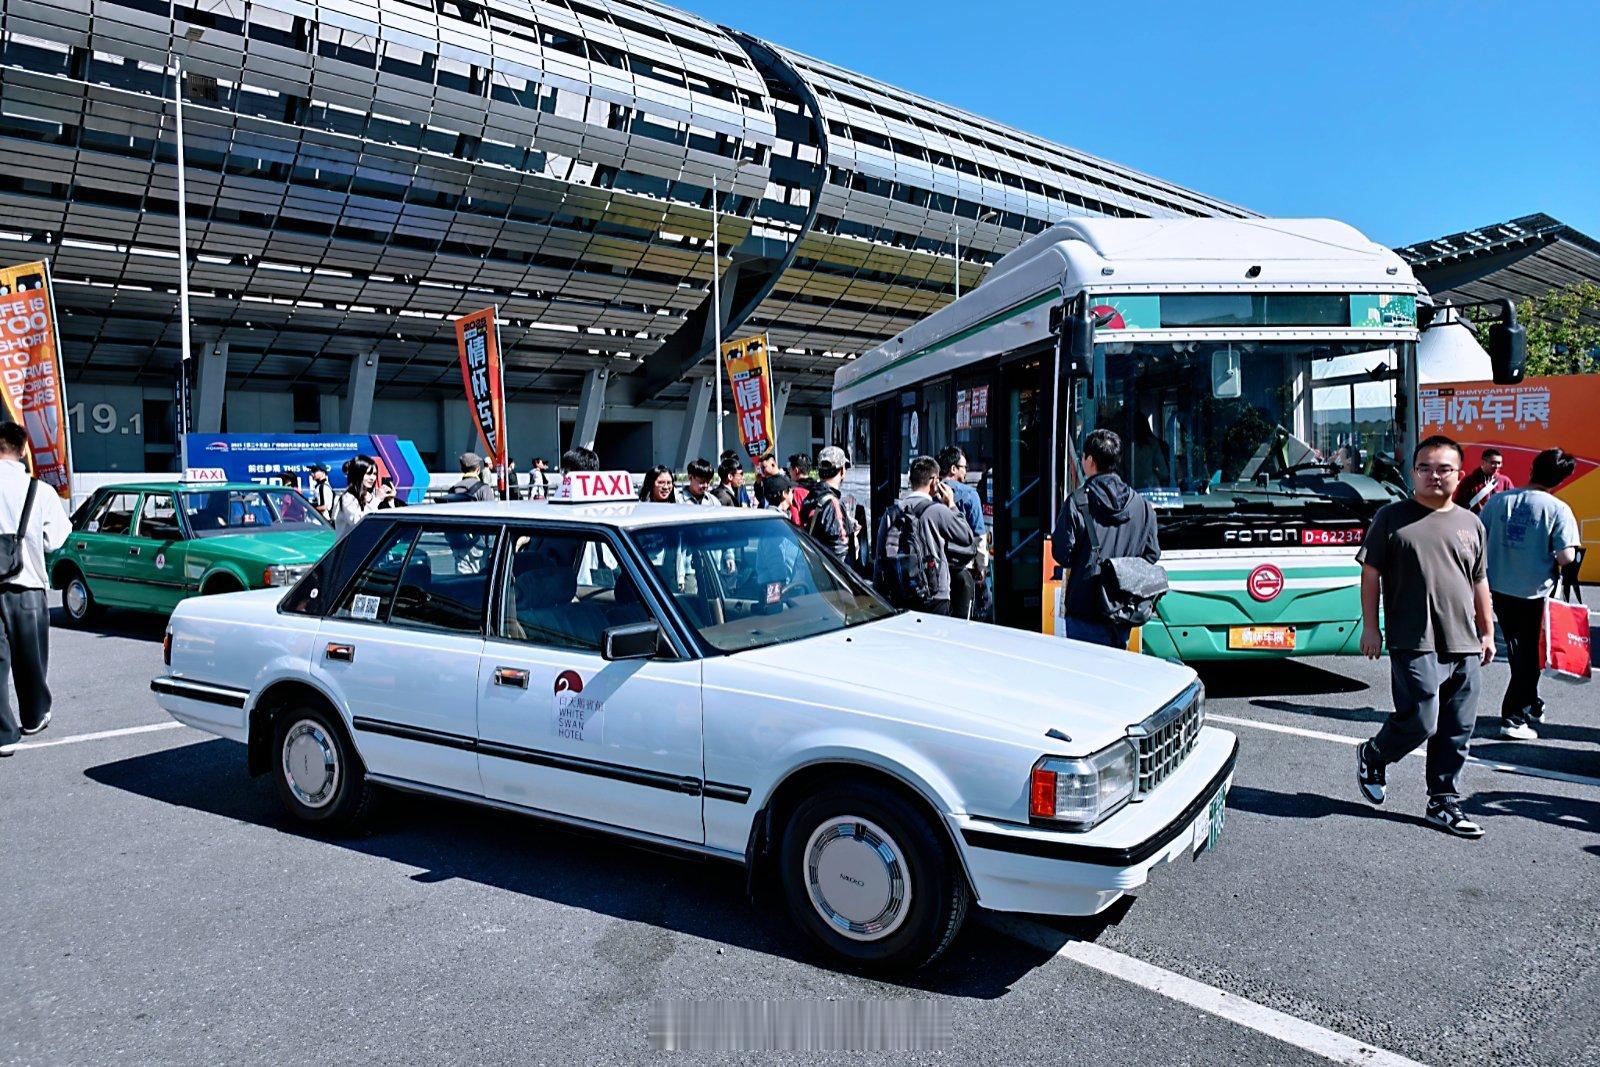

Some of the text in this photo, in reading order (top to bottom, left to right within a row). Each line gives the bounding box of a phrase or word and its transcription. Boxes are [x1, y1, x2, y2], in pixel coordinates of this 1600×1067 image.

[29, 297, 45, 312] IS
[464, 317, 487, 331] 2025
[0, 332, 48, 352] SHORT
[2, 352, 30, 367] TO
[4, 360, 53, 384] DRIVE
[9, 376, 55, 397] BORING
[1455, 388, 1503, 396] OHMYCAR
[1504, 386, 1550, 394] FESTIVAL
[13, 388, 55, 410] CARS
[1420, 393, 1550, 426] 情怀车展
[69, 403, 140, 434] 19.1
[190, 470, 223, 480] TAXI
[283, 464, 301, 473] THIS
[562, 475, 571, 498] 的士
[576, 475, 631, 496] TAXI
[1224, 528, 1362, 543] FOTON D-62234
[559, 707, 585, 720] WHITE
[558, 718, 584, 731] SWAN
[558, 729, 584, 741] HOTEL
